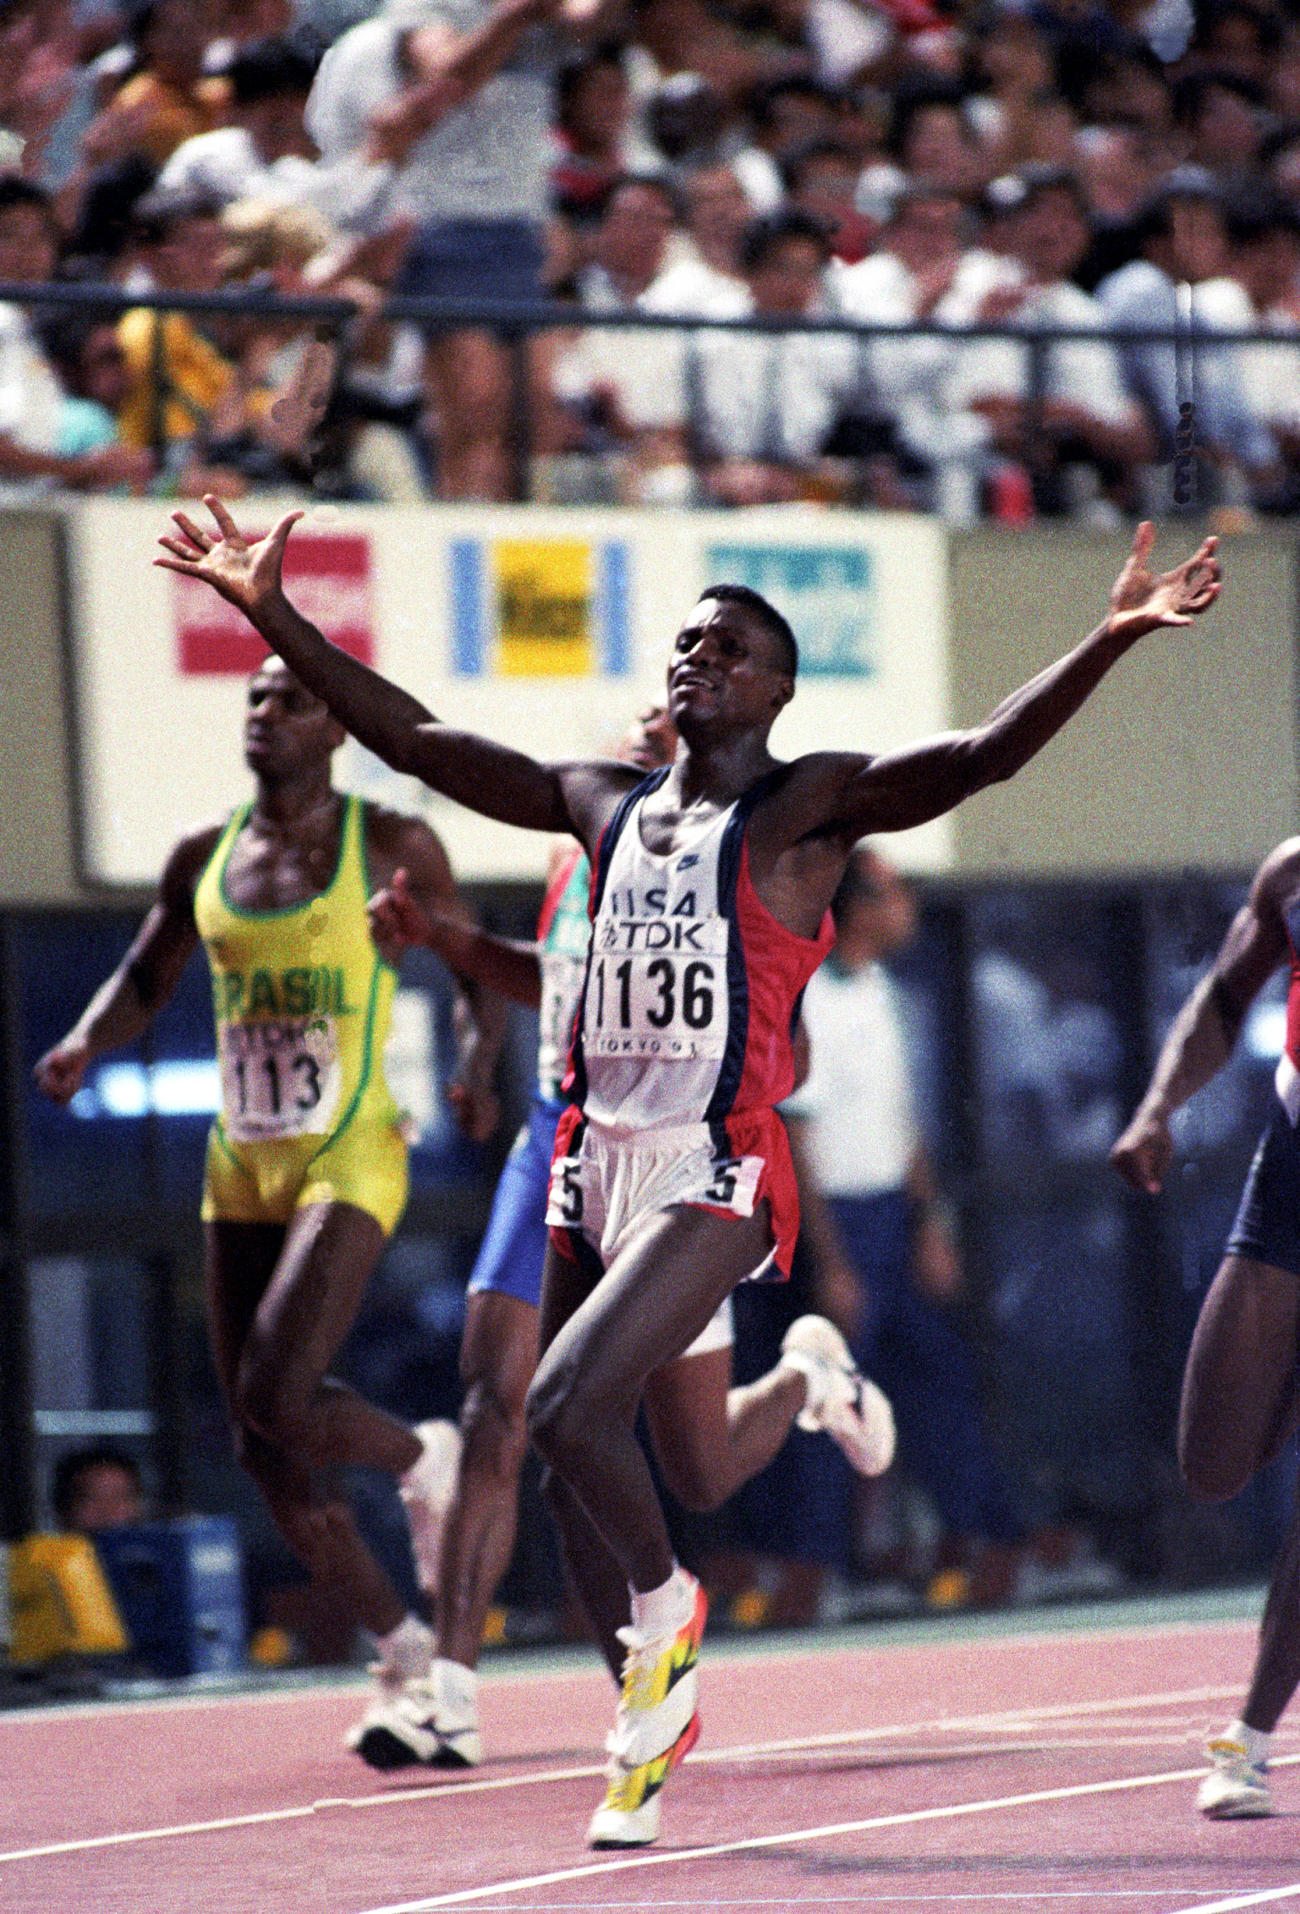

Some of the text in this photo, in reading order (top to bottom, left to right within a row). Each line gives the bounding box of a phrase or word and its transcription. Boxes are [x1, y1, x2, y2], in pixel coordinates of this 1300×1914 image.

[612, 888, 697, 917] USA
[620, 921, 704, 950] TDK
[597, 958, 714, 1029] 1136
[236, 1053, 321, 1114] 113
[562, 1164, 584, 1222] 5
[706, 1159, 743, 1203] 5
